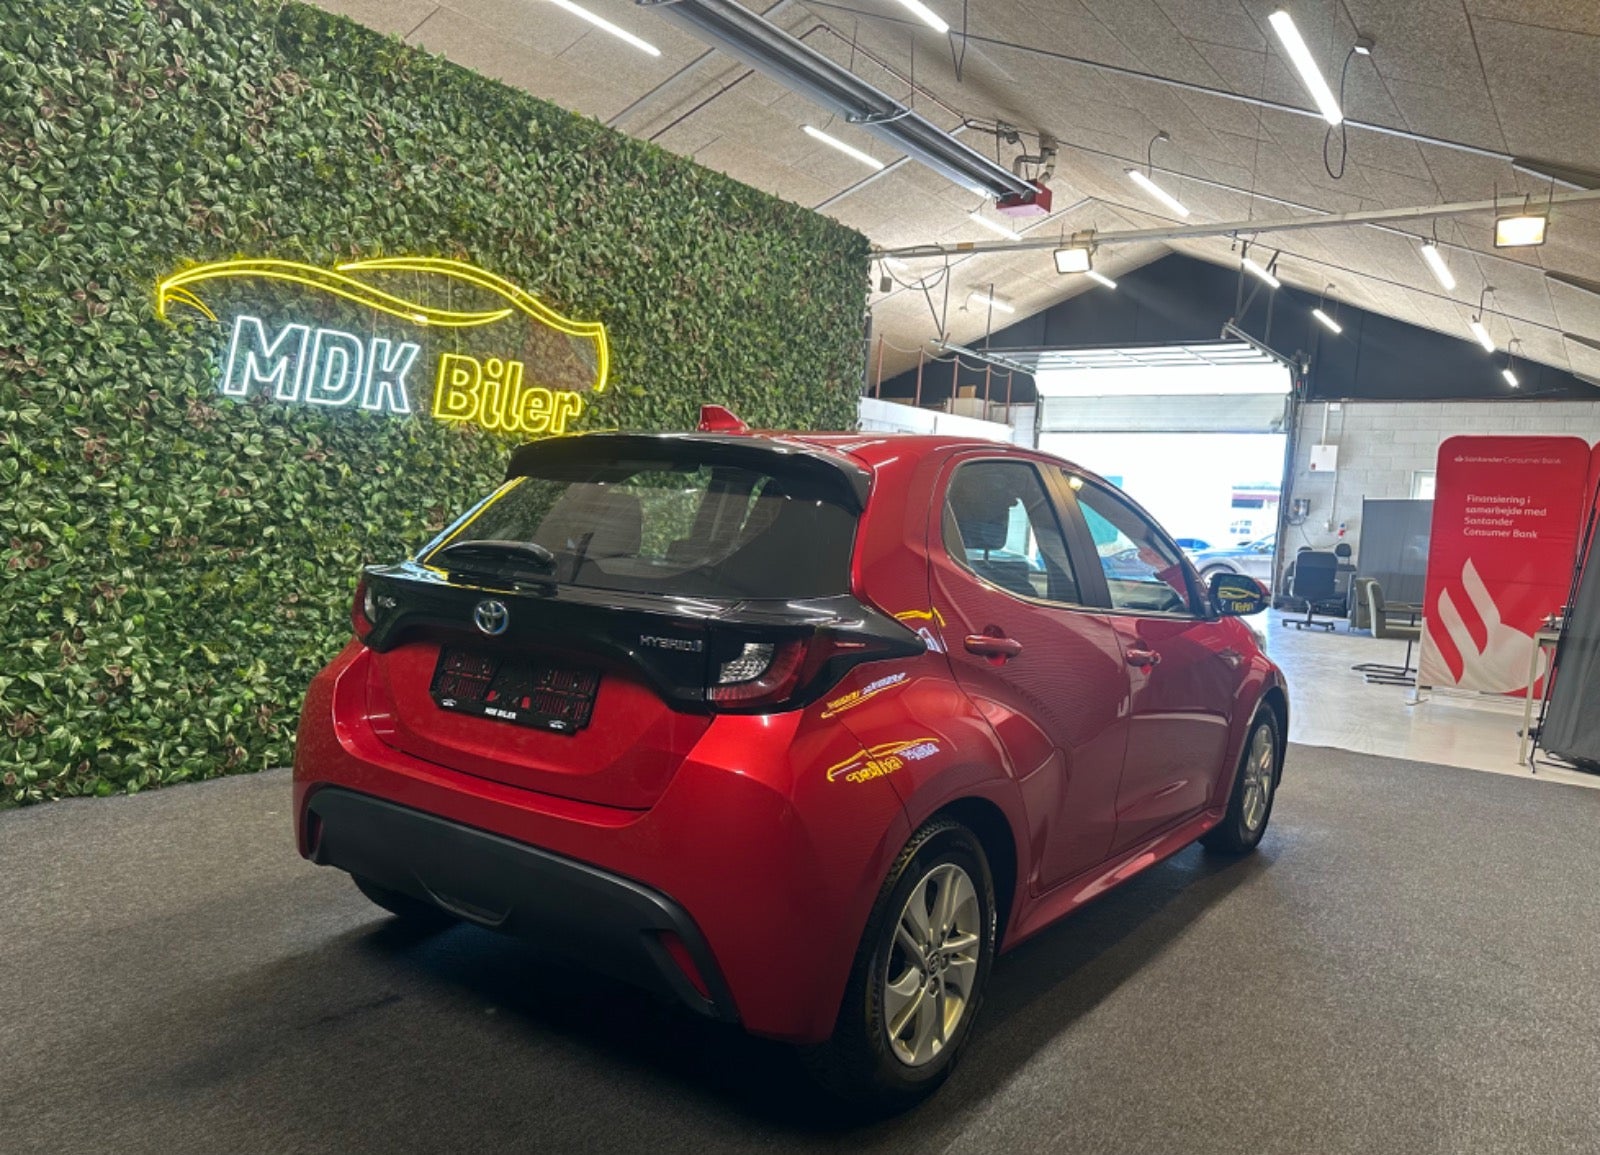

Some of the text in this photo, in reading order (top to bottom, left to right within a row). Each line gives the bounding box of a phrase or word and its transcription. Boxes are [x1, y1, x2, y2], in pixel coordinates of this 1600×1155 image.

[222, 314, 582, 434] MDK Biler
[1466, 494, 1525, 506] Finansiering
[1465, 506, 1547, 517] samarbejde med
[1463, 516, 1514, 526] Santander
[1463, 527, 1538, 539] Consumer Bank
